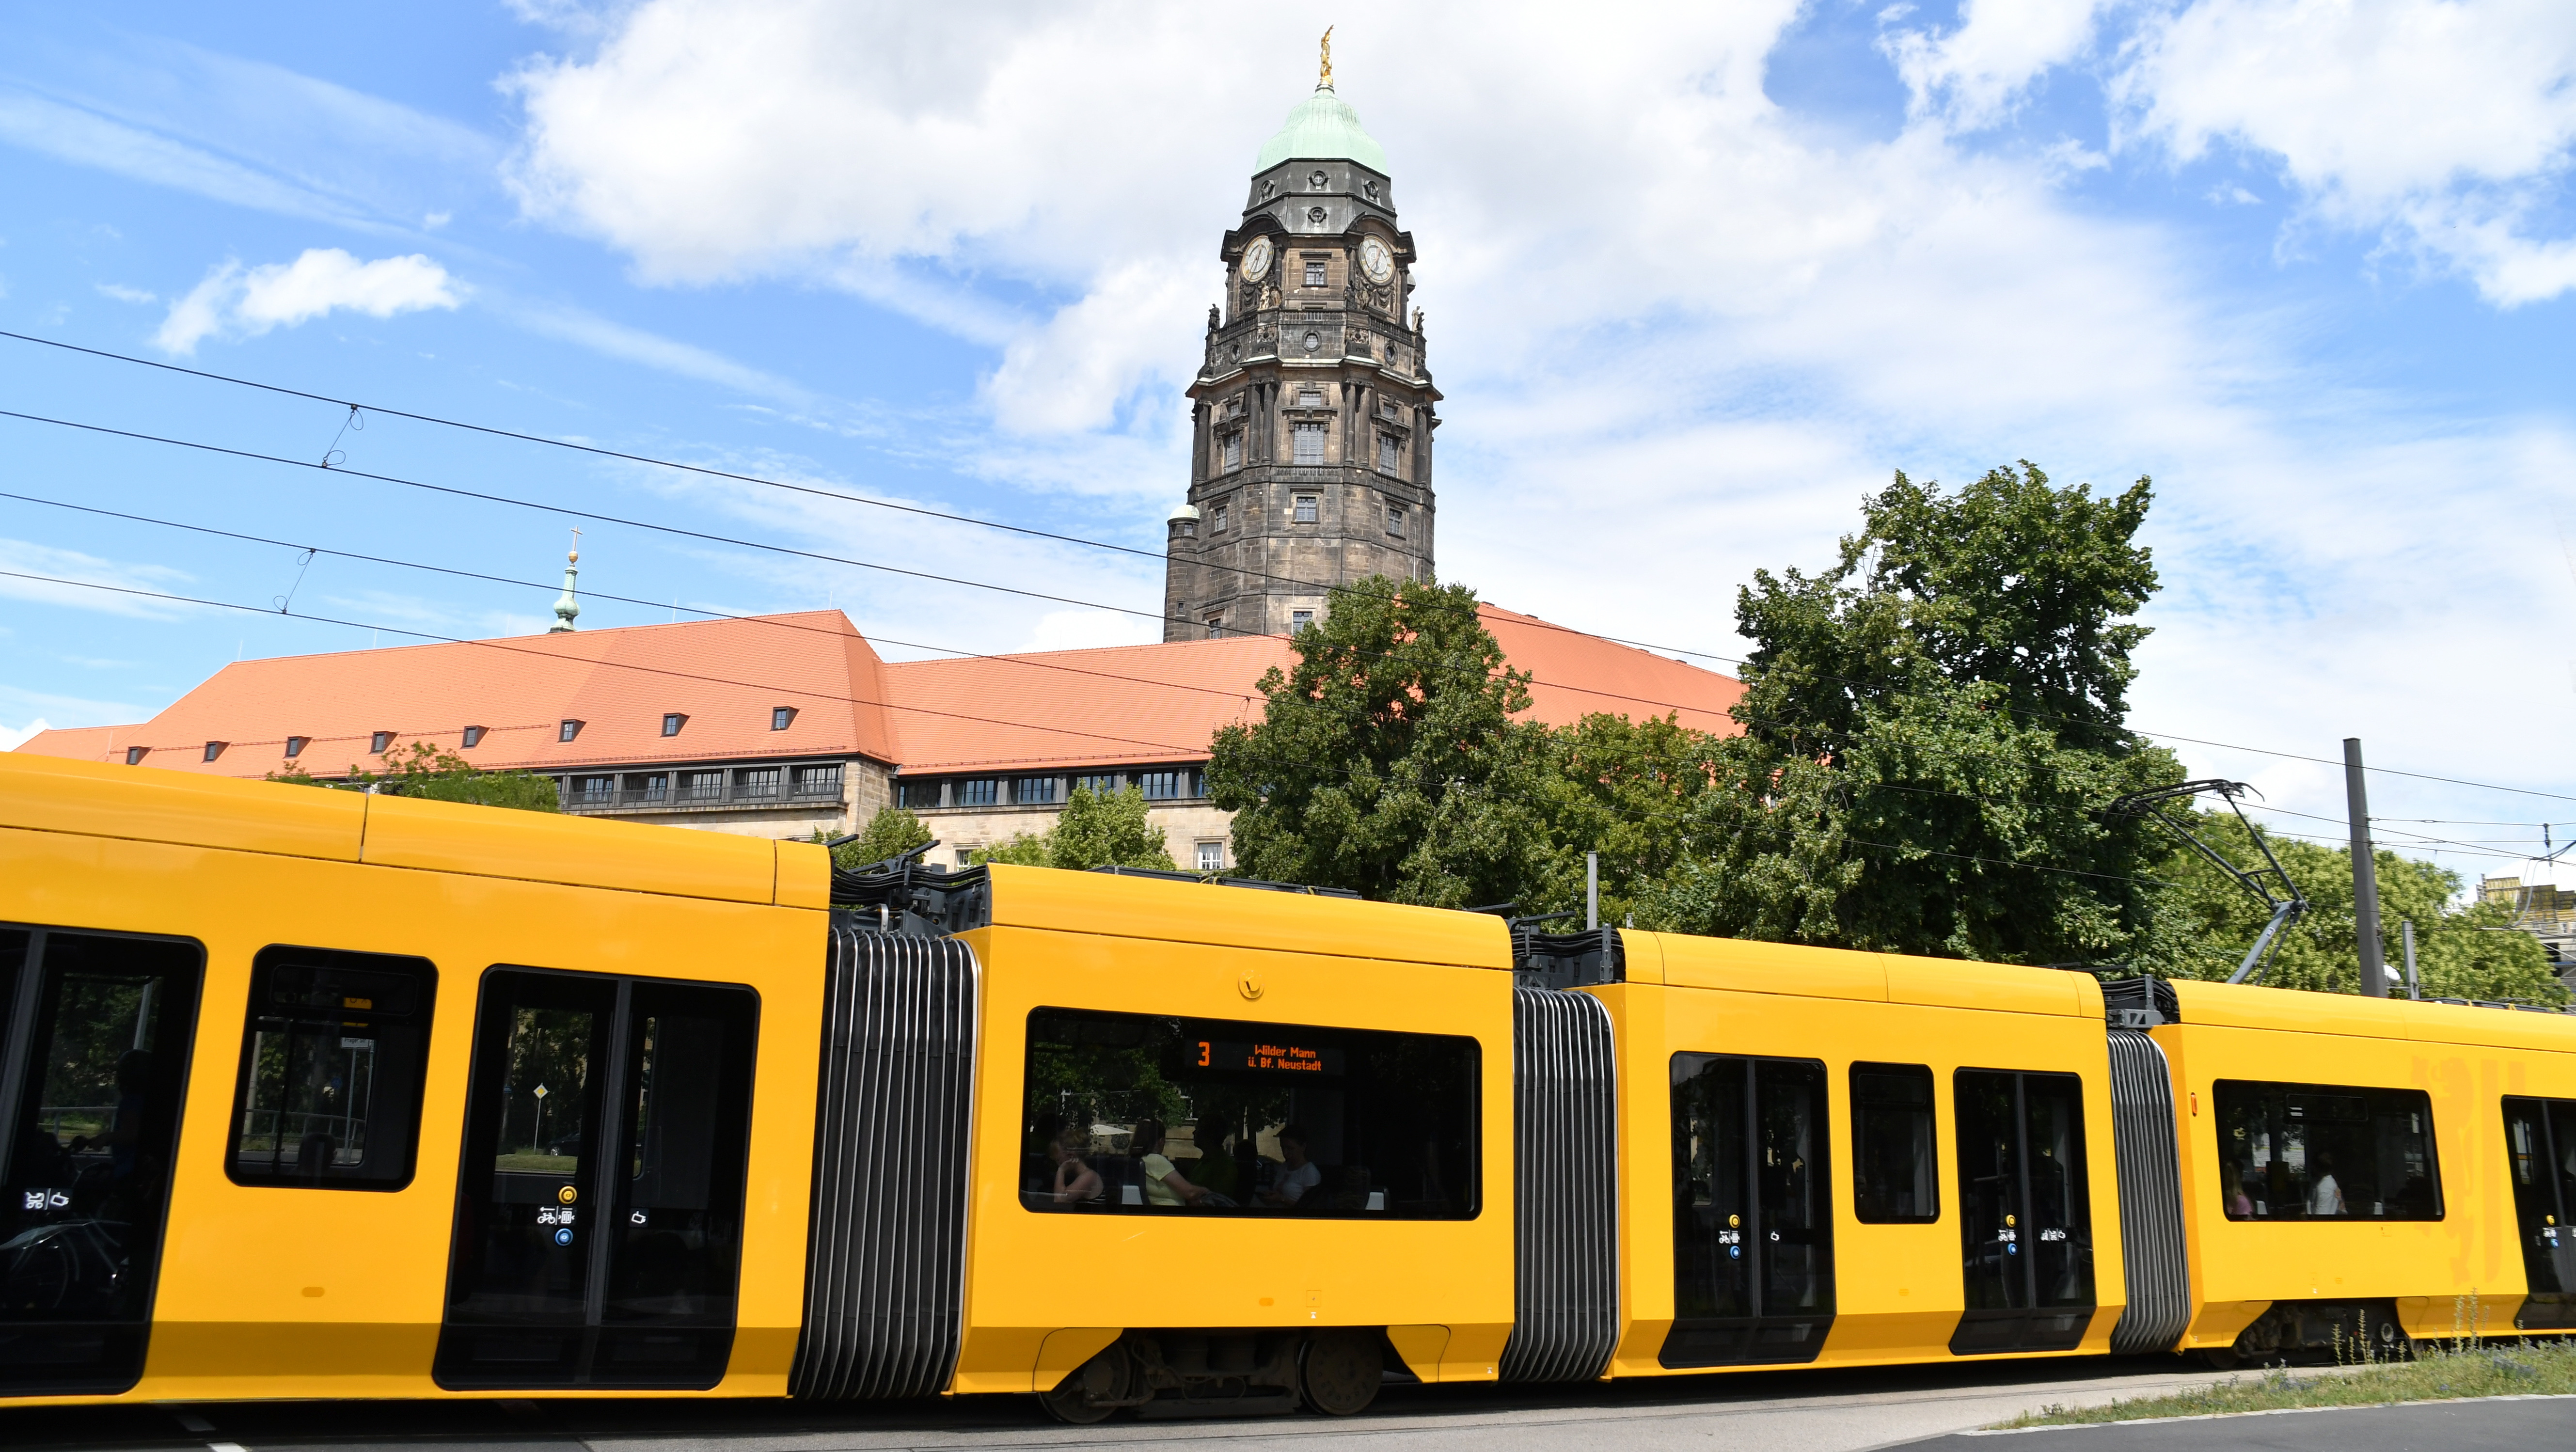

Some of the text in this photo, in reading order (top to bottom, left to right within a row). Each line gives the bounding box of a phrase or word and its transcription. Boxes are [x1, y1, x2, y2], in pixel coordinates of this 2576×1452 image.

[1198, 1042, 1210, 1066] 3
[1255, 1044, 1316, 1058] Wilder Mann
[1248, 1056, 1321, 1071] ü. Bf. Neustadt
